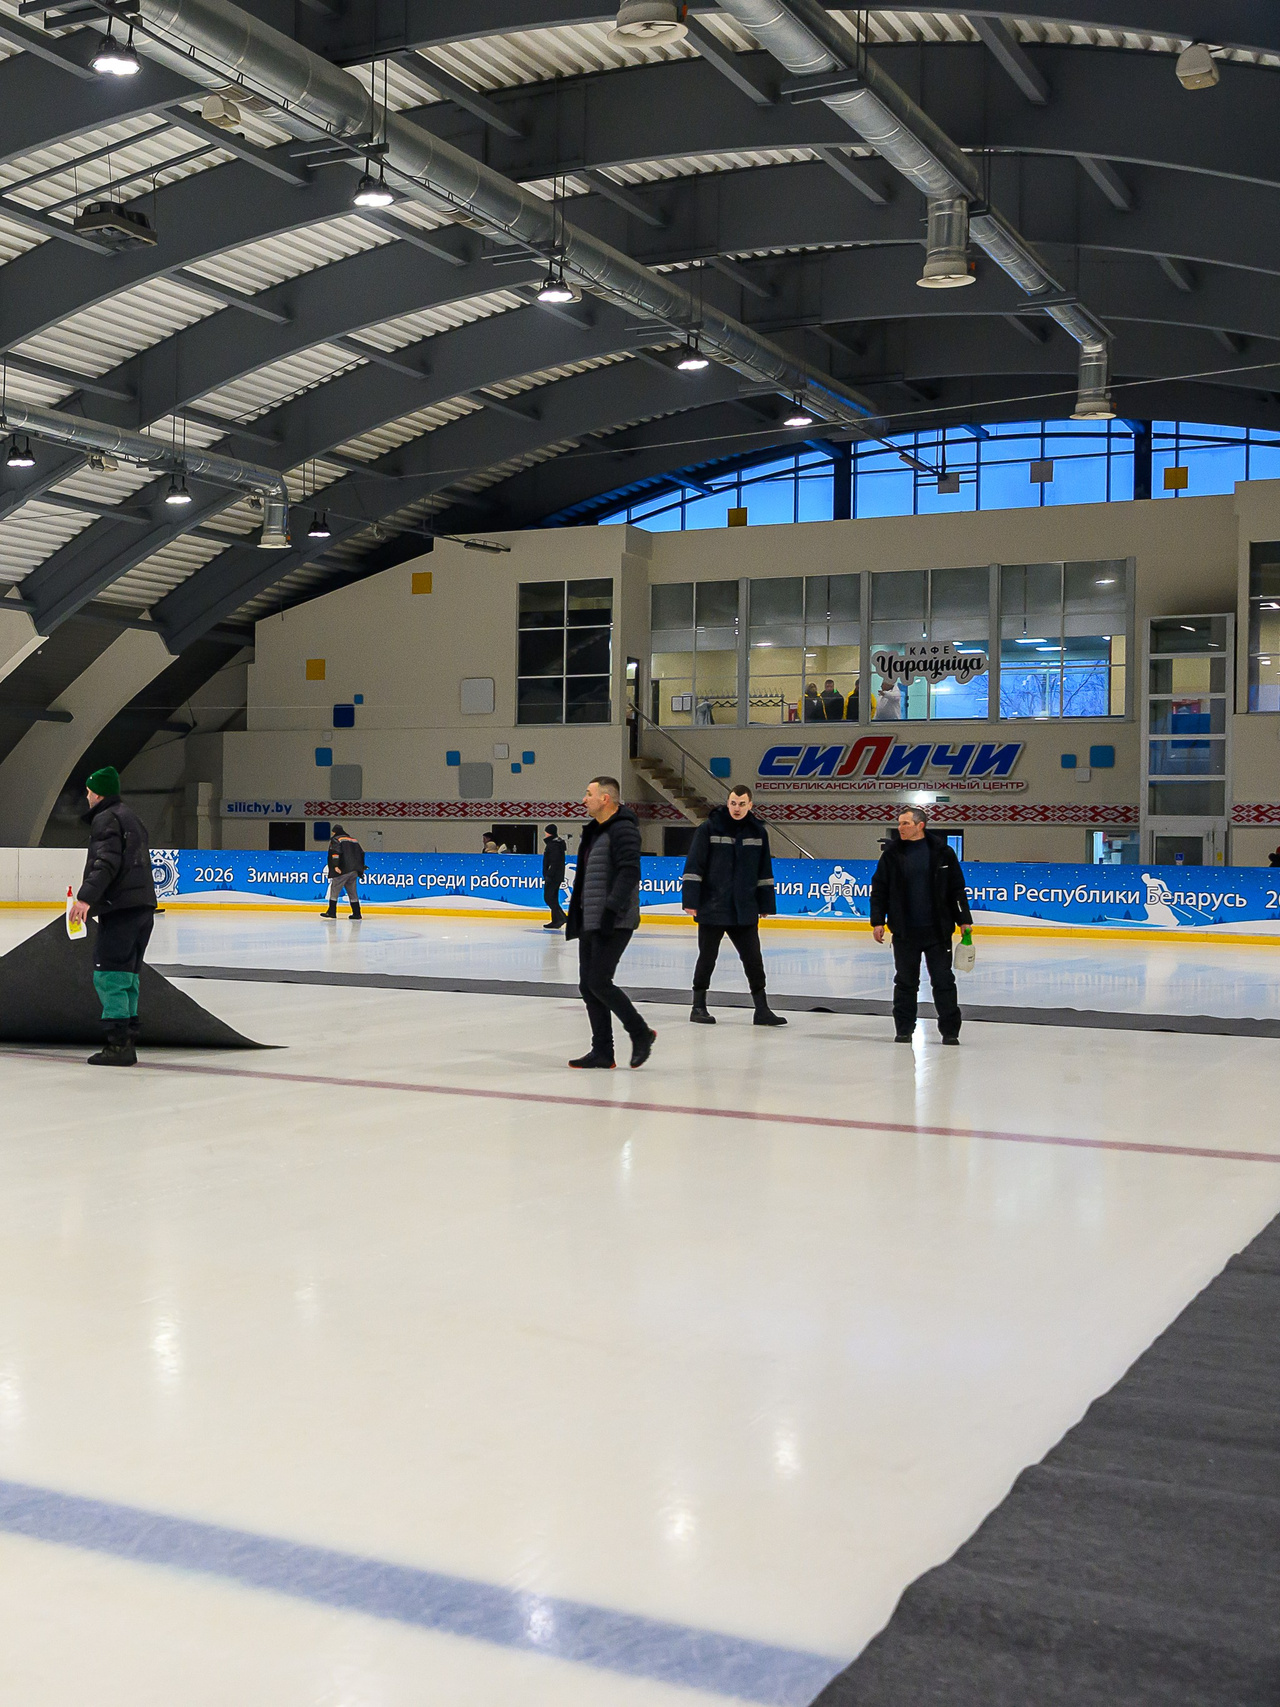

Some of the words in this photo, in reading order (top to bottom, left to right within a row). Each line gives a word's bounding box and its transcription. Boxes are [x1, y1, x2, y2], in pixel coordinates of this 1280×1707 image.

[909, 645, 950, 655] КАФЕ
[876, 655, 984, 681] Чараўніца
[755, 780, 876, 791] РЕСПУБЛИКАНСКИЙ
[878, 780, 979, 791] ГОРНОЛЫЖНЫЙ
[982, 781, 1024, 791] ЦЕНТР
[227, 802, 292, 815] silichy.by
[194, 867, 234, 883] 2026
[247, 867, 308, 884] Зимняя
[418, 874, 466, 890] среди
[1013, 883, 1140, 907] Республики
[1146, 886, 1248, 912] Беларусь
